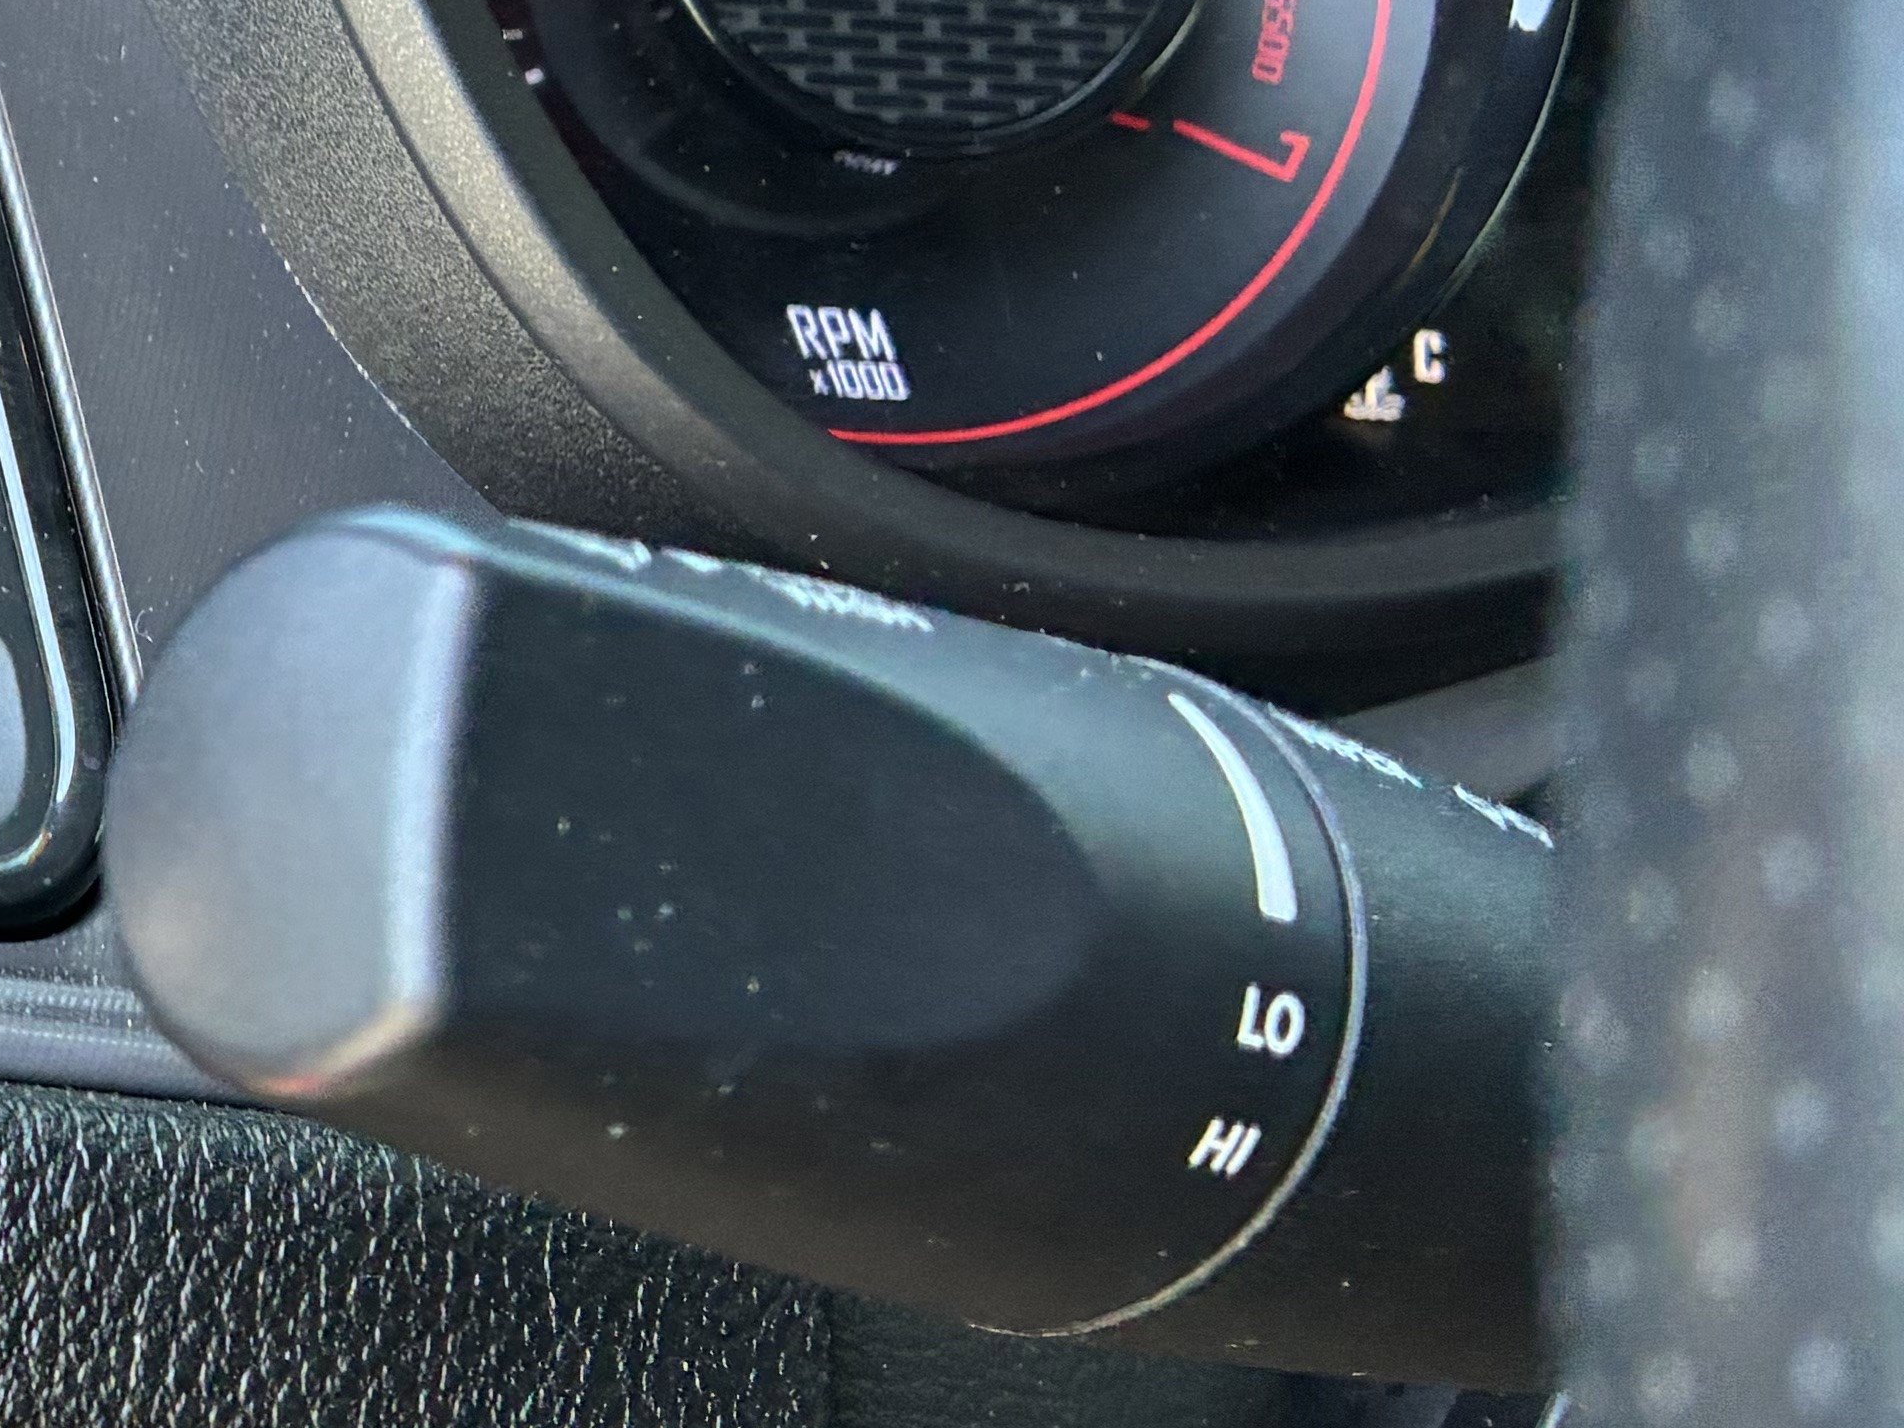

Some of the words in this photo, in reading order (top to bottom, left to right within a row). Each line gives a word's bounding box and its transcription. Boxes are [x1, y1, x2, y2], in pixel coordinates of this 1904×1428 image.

[1171, 118, 1312, 183] 7
[786, 303, 897, 364] RPM
[1412, 328, 1448, 385] C
[808, 359, 912, 402] x1000
[1236, 981, 1306, 1058] LO
[1187, 1116, 1262, 1180] HI
